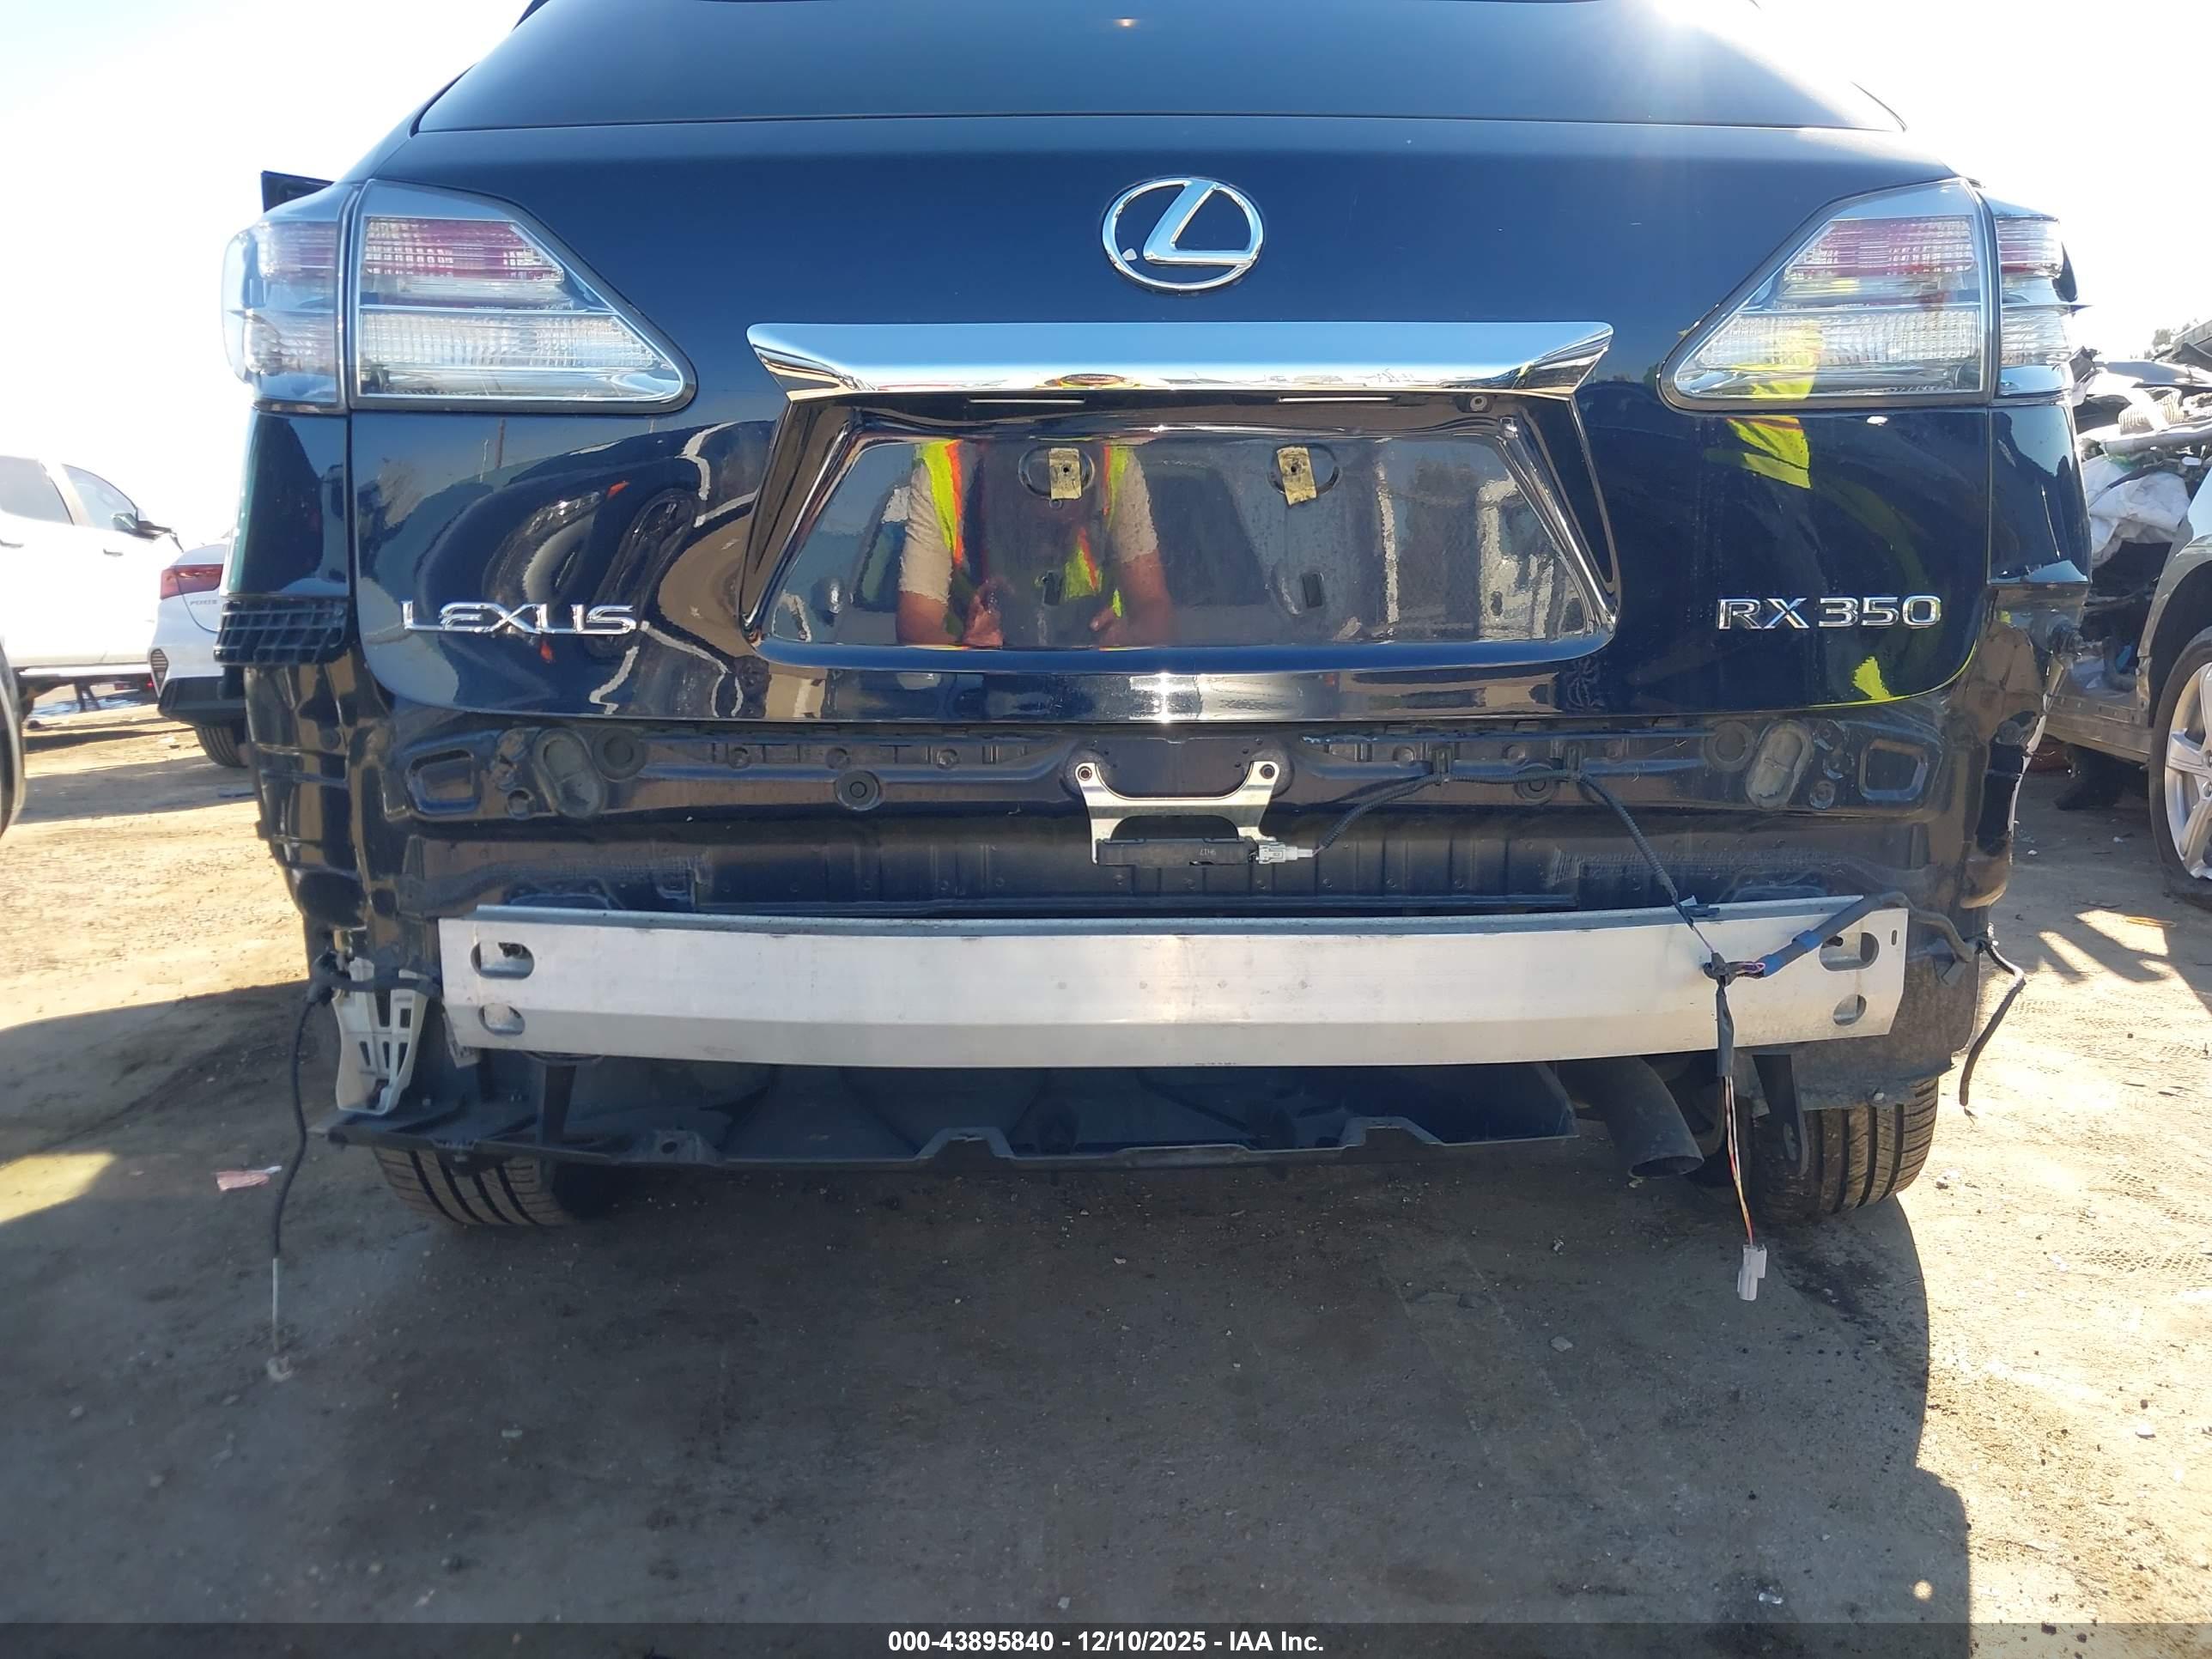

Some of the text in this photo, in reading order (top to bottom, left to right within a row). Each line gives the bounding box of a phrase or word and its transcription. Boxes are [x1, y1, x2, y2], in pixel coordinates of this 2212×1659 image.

[401, 600, 637, 635] LEXUS
[1718, 596, 1942, 629] RX 350
